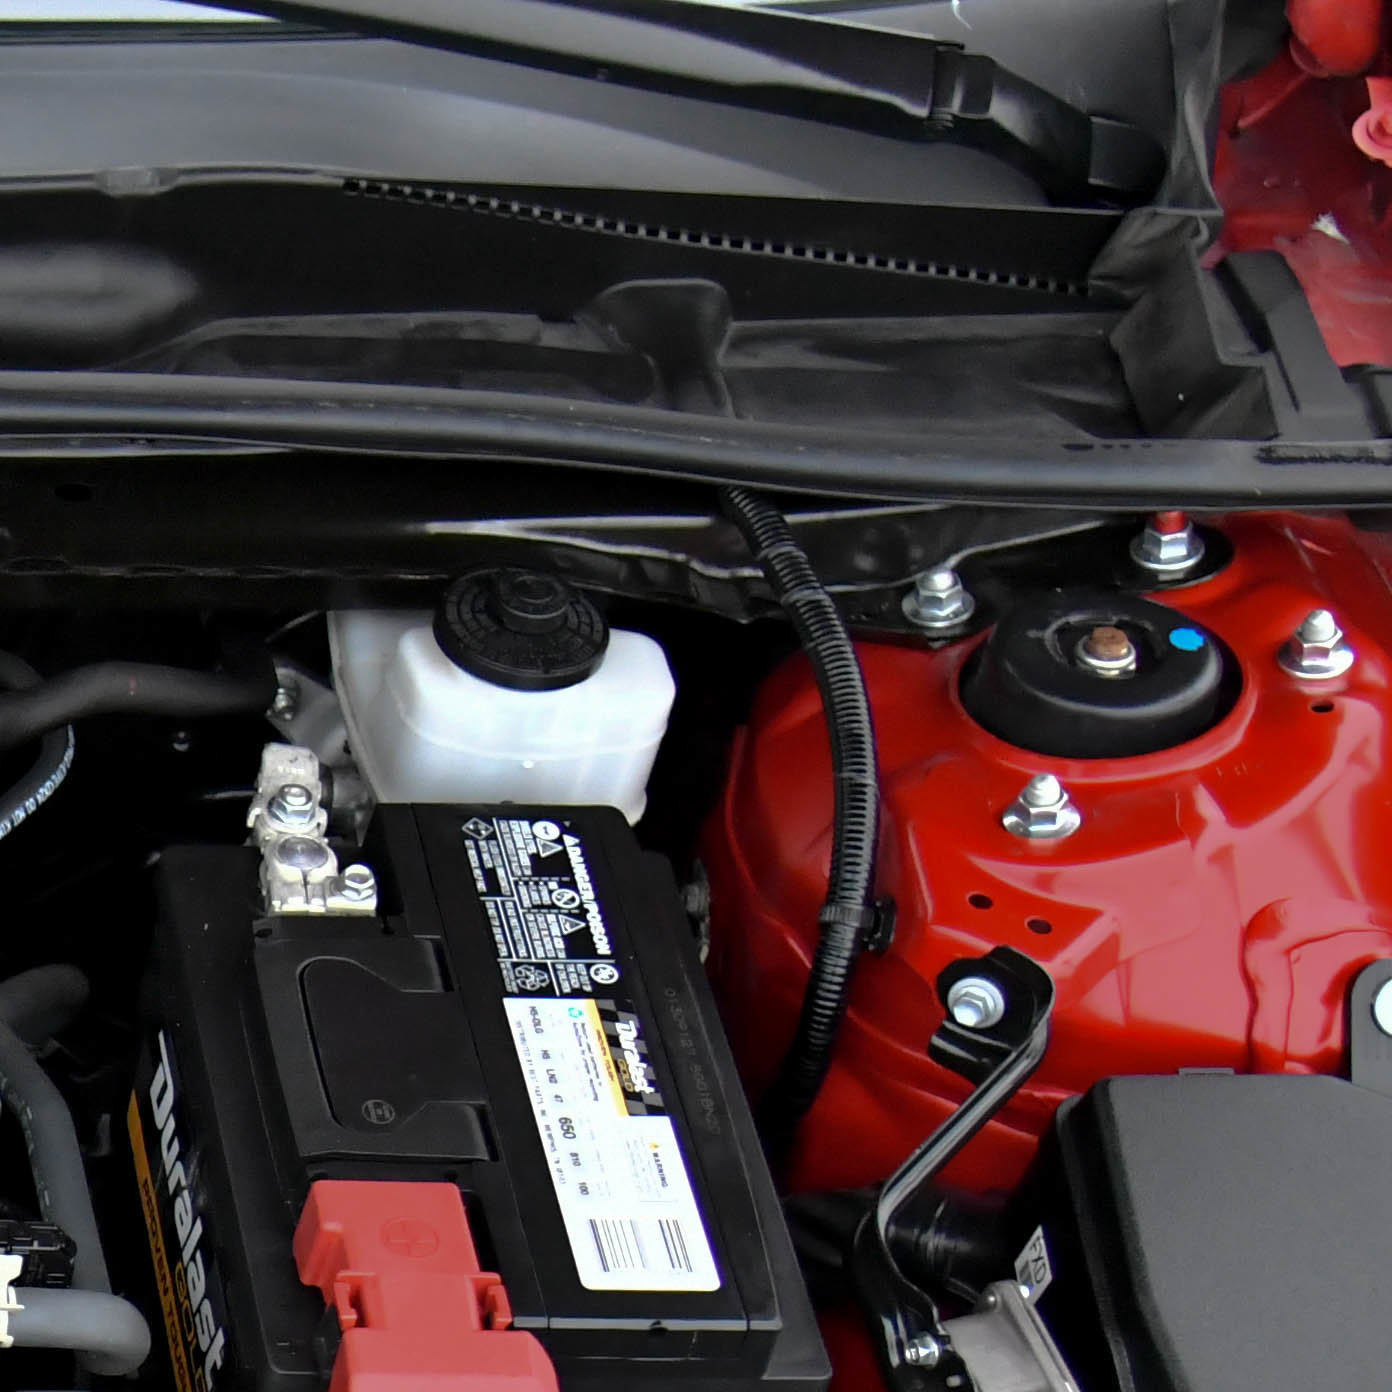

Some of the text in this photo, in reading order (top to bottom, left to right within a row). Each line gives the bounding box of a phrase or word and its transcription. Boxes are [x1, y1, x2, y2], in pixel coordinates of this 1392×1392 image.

[566, 846, 612, 955] DANGER/POISON
[616, 1020, 655, 1094] Duralast
[617, 1058, 634, 1092] GOLD
[558, 1117, 577, 1139] 650
[578, 1181, 590, 1196] 100
[653, 1152, 669, 1187] WARNING
[142, 1177, 168, 1298] PROVEN
[150, 1028, 224, 1391] Duralast
